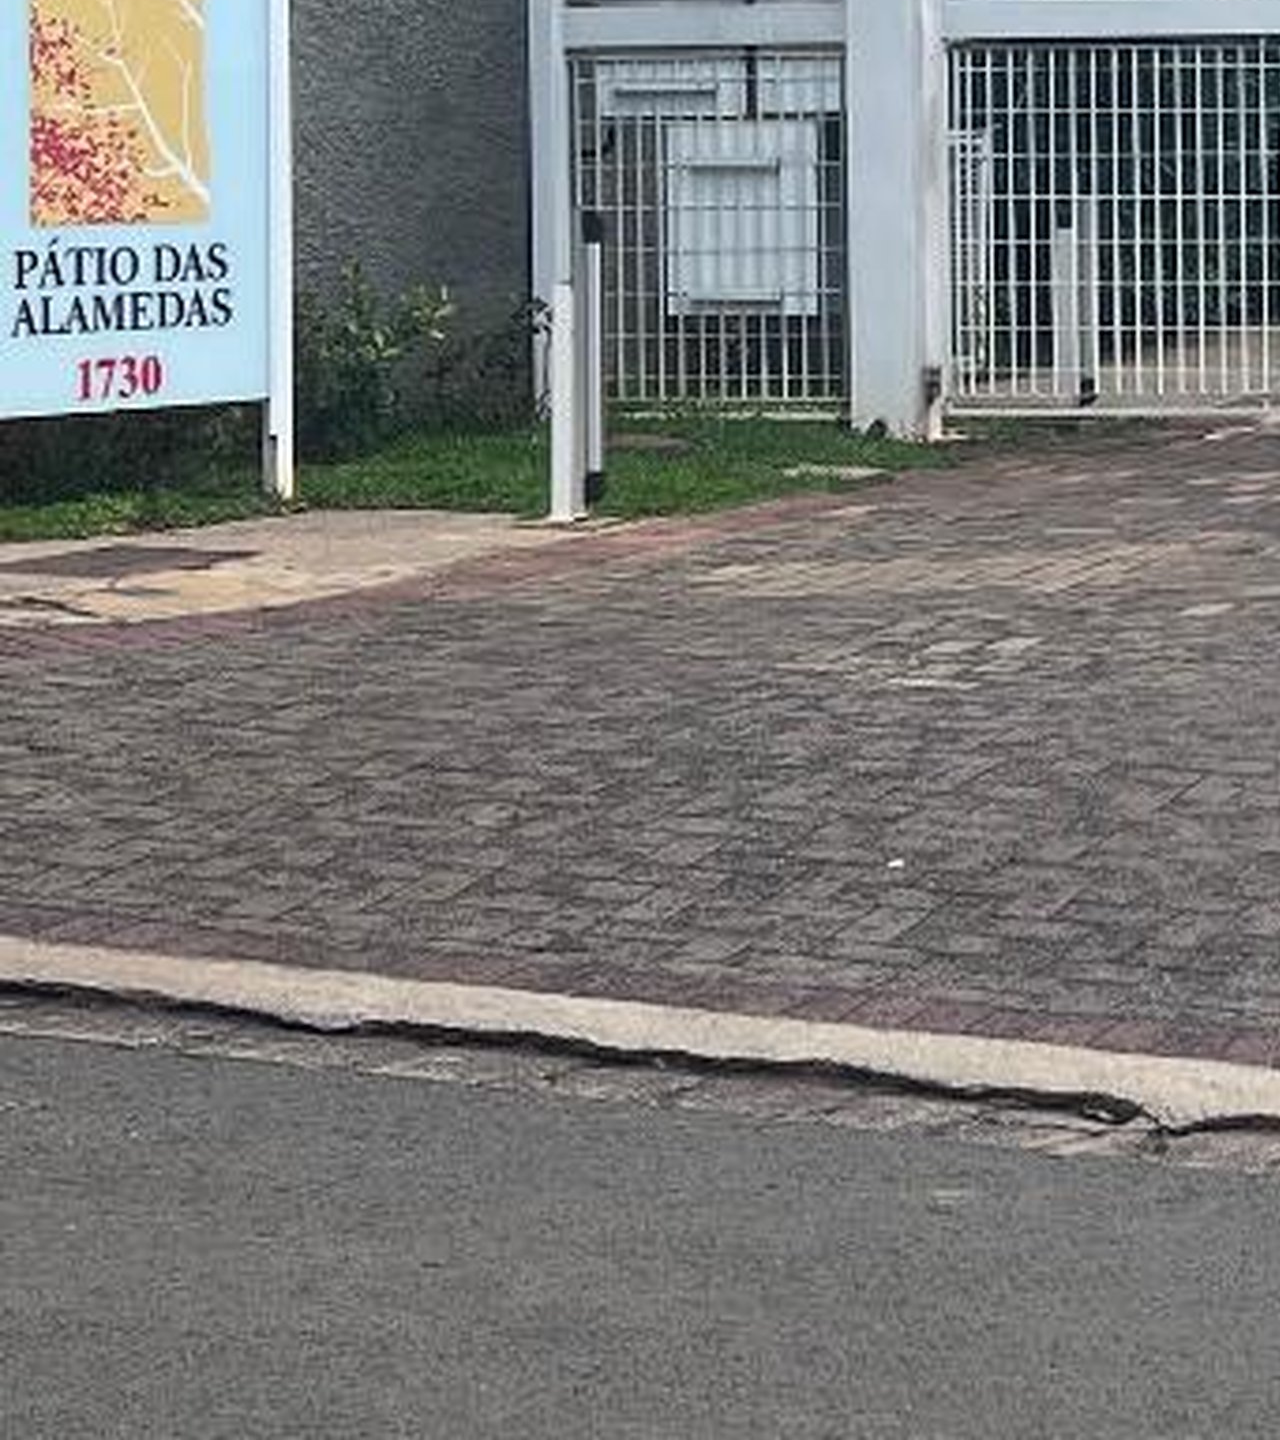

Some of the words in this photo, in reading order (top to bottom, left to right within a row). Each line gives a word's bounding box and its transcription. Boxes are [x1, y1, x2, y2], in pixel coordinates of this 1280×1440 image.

[14, 237, 140, 290] PÁTIO
[153, 242, 229, 283] DAS
[11, 287, 233, 338] ALAMEDAS
[76, 355, 163, 401] 1730
